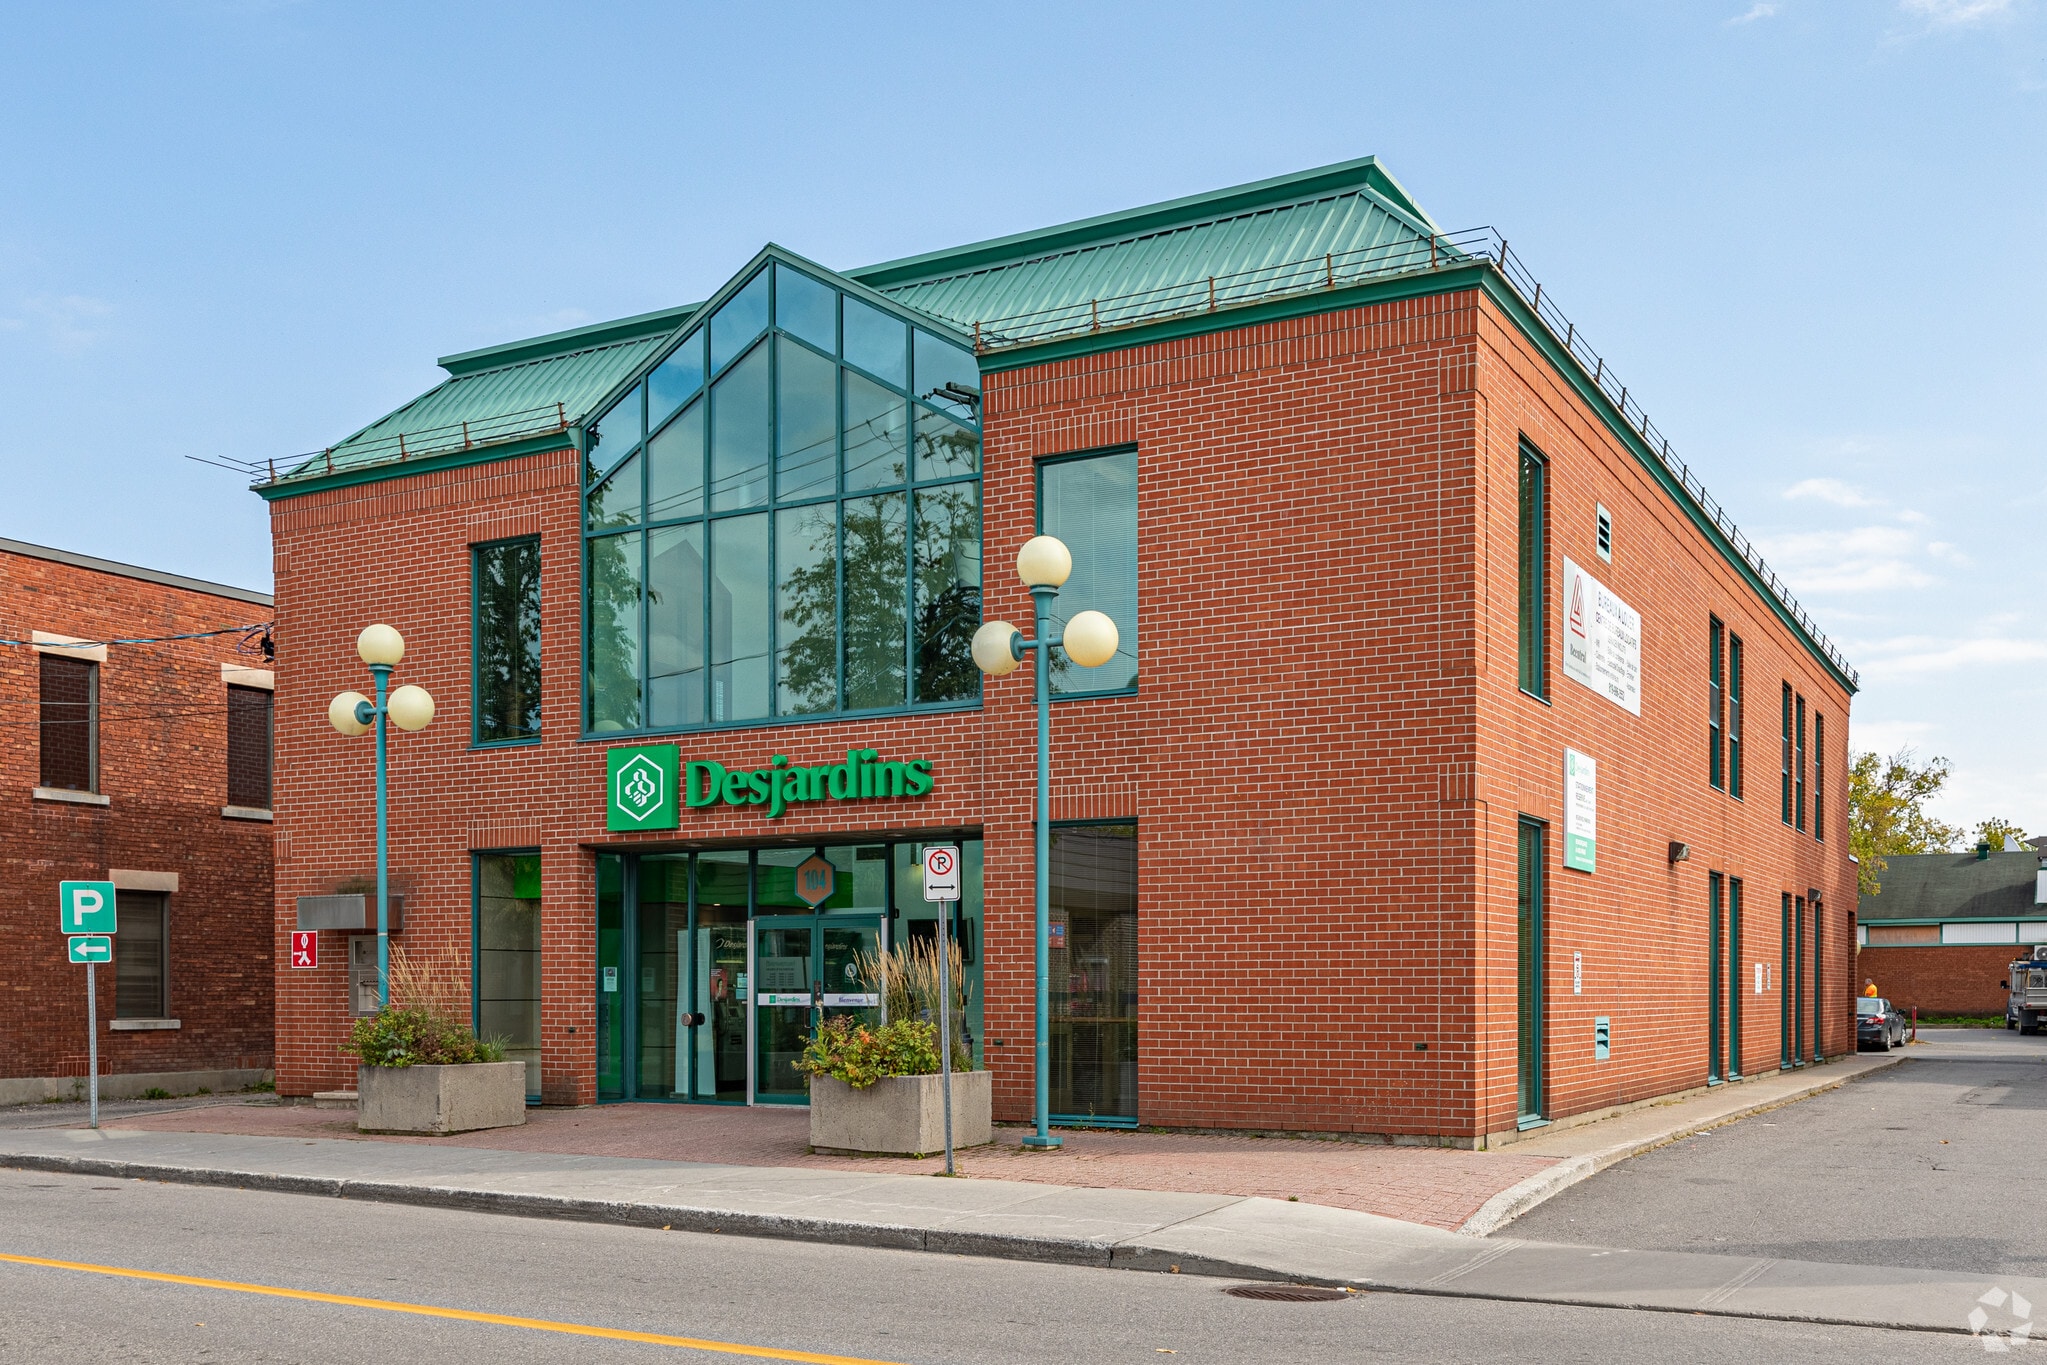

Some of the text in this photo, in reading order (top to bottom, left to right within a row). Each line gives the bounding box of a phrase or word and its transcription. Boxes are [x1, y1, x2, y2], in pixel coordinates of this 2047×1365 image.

[686, 748, 933, 819] Desjardins
[804, 868, 826, 891] 104
[73, 889, 104, 926] P
